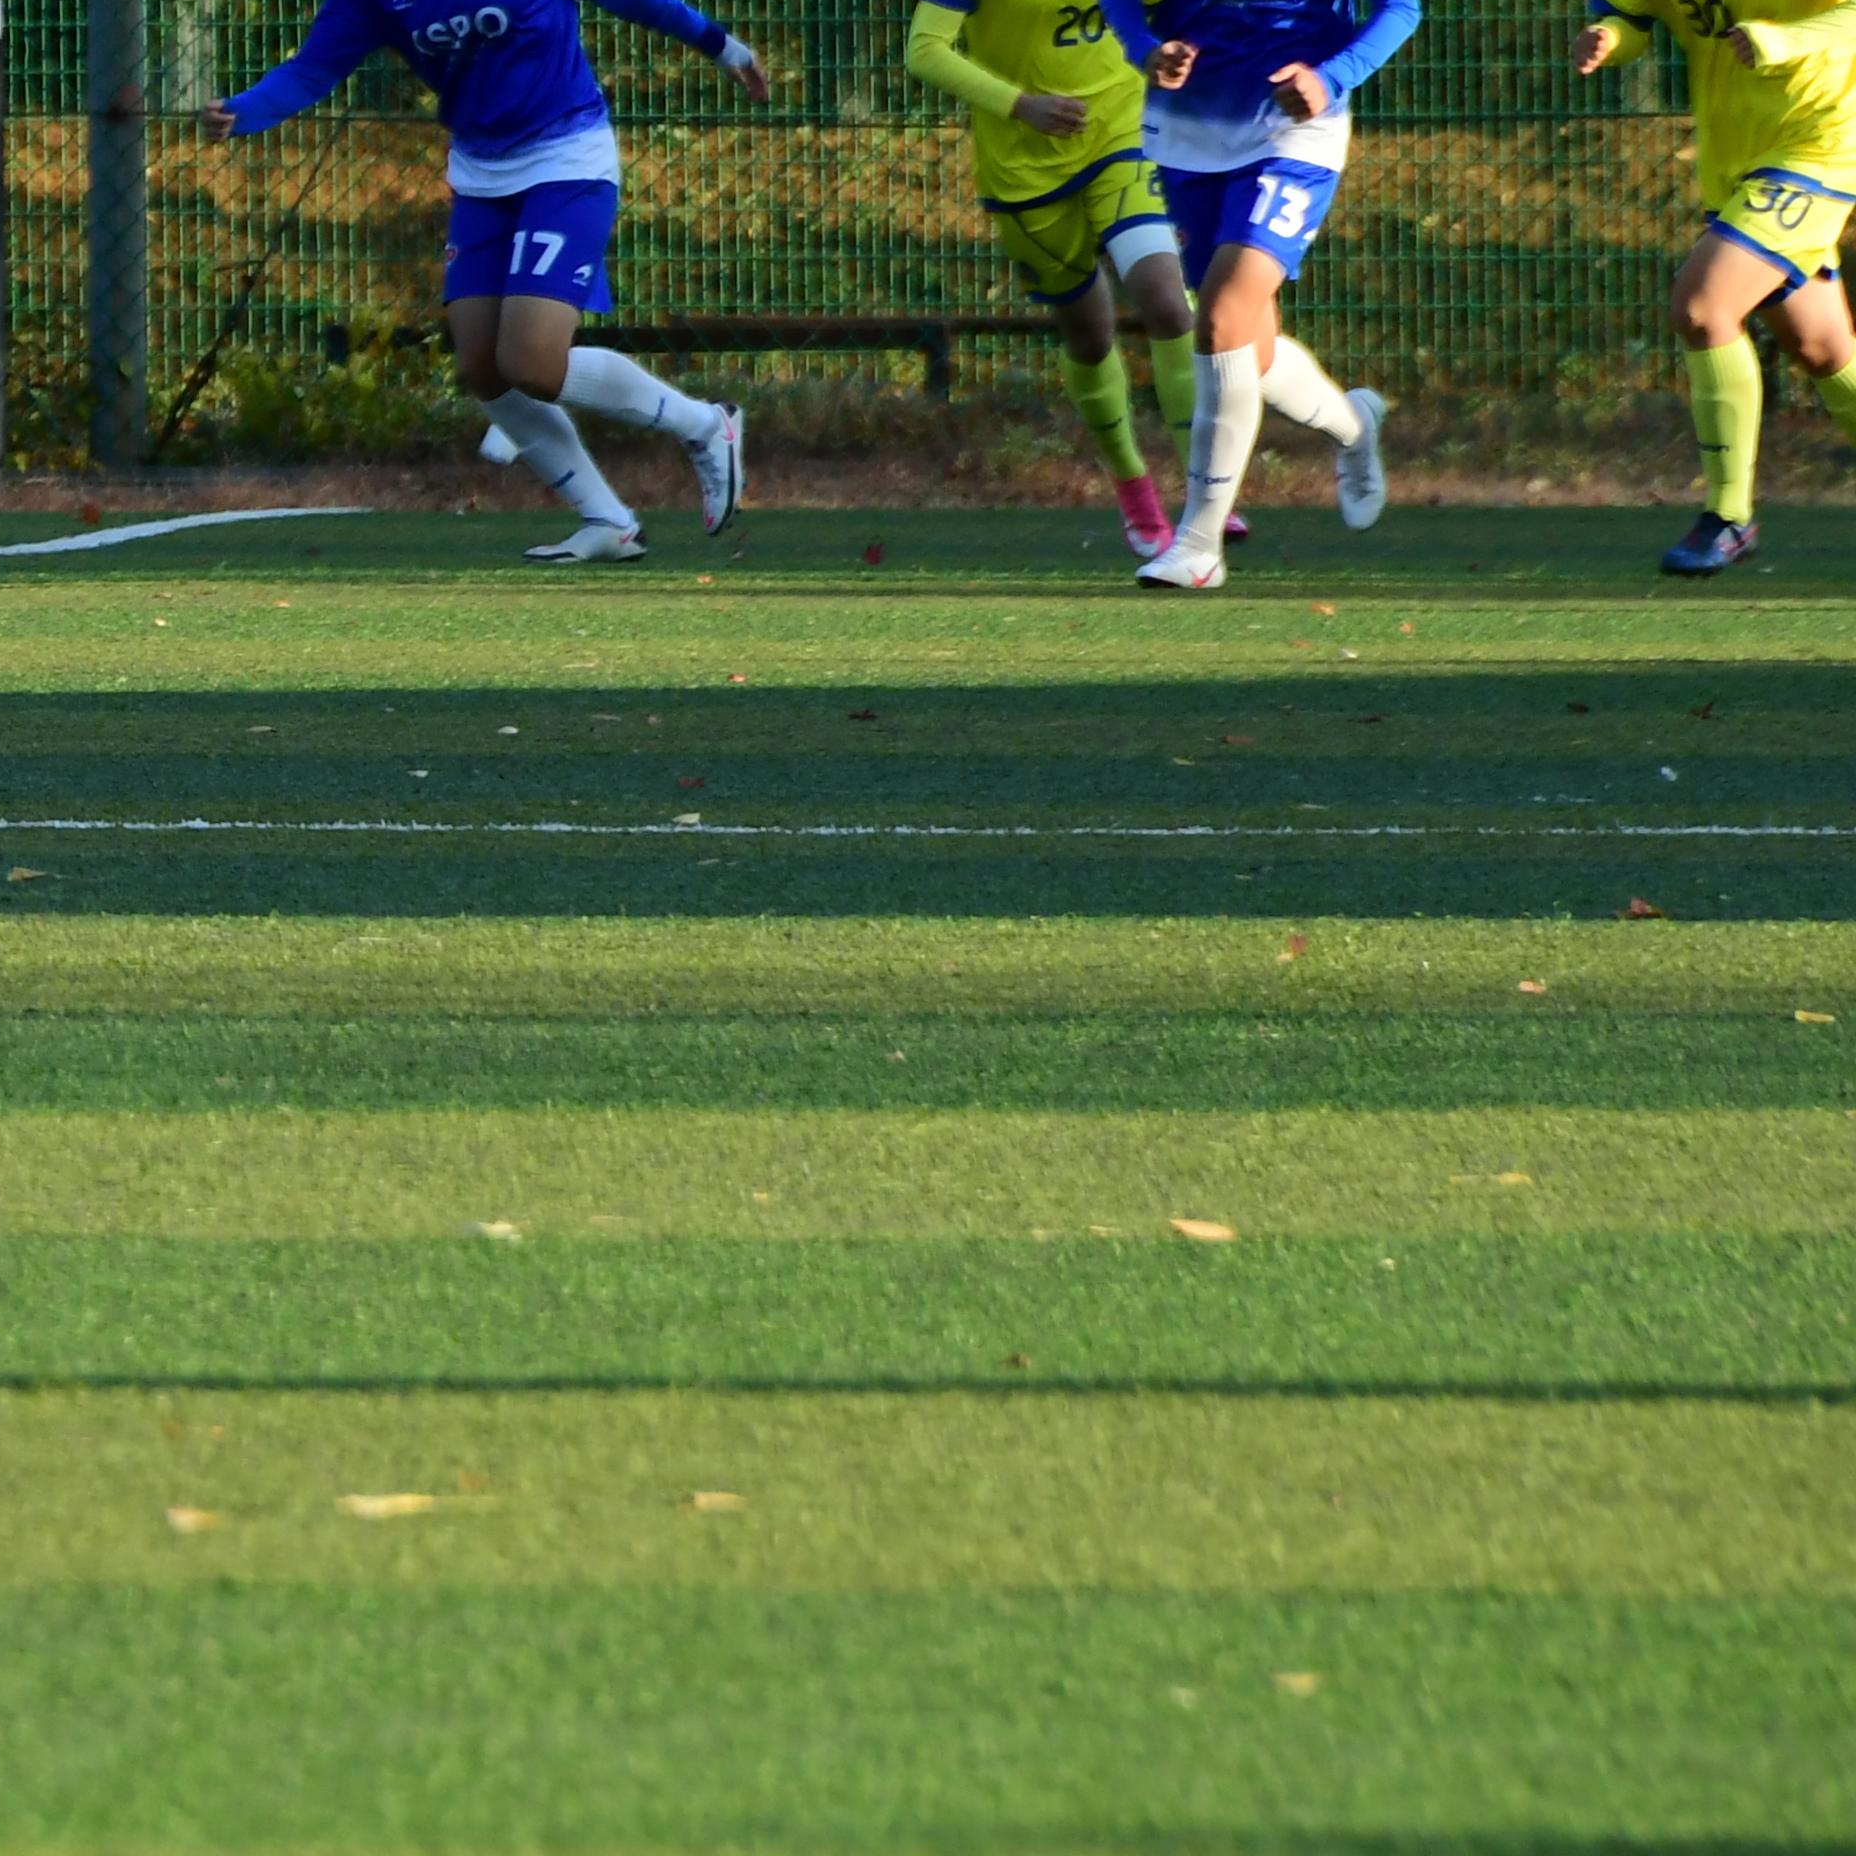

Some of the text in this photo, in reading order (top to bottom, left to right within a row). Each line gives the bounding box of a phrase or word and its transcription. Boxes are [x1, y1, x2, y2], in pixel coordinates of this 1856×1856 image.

[1052, 5, 1106, 48] 20
[1248, 174, 1312, 239] 13
[1742, 180, 1814, 232] 30
[509, 229, 566, 276] 17
